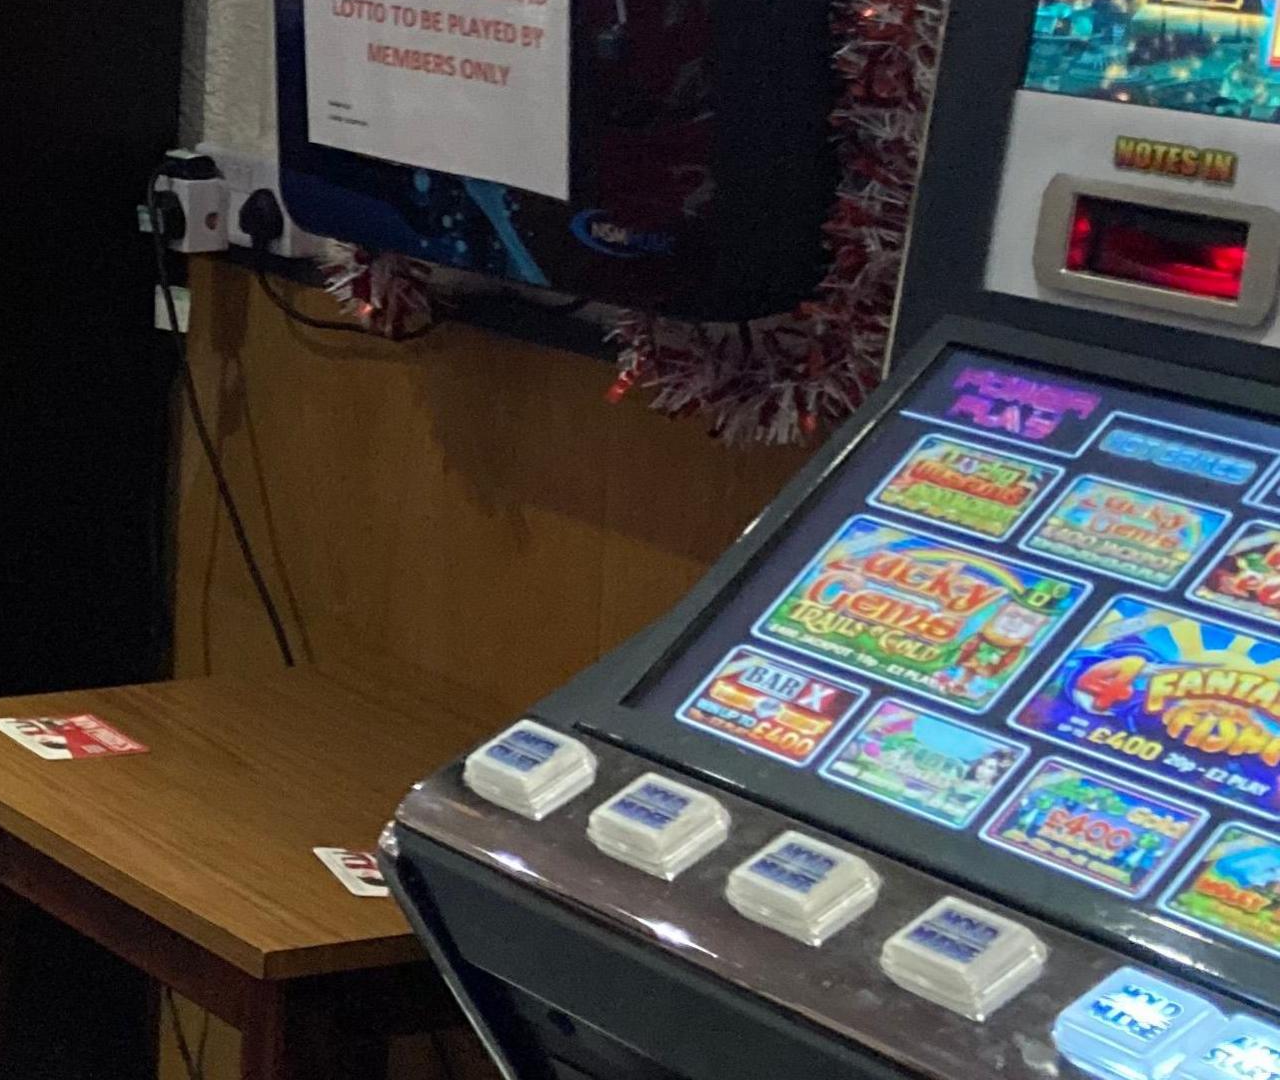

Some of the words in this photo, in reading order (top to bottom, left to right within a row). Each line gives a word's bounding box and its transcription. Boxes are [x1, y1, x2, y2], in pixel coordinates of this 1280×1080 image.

[391, 5, 416, 27] TO
[422, 10, 442, 32] BE
[448, 14, 517, 43] PLAYED
[522, 25, 544, 47] BY
[367, 43, 456, 76] MEMBERS
[460, 59, 511, 86] ONLY
[1117, 137, 1198, 176] NOTES
[1202, 151, 1234, 183] IN
[825, 549, 1006, 616] Lucky
[806, 571, 965, 642] Gems
[745, 664, 802, 698] BAR
[806, 682, 835, 712] X
[1077, 655, 1146, 713] 4
[1089, 727, 1163, 761] £400
